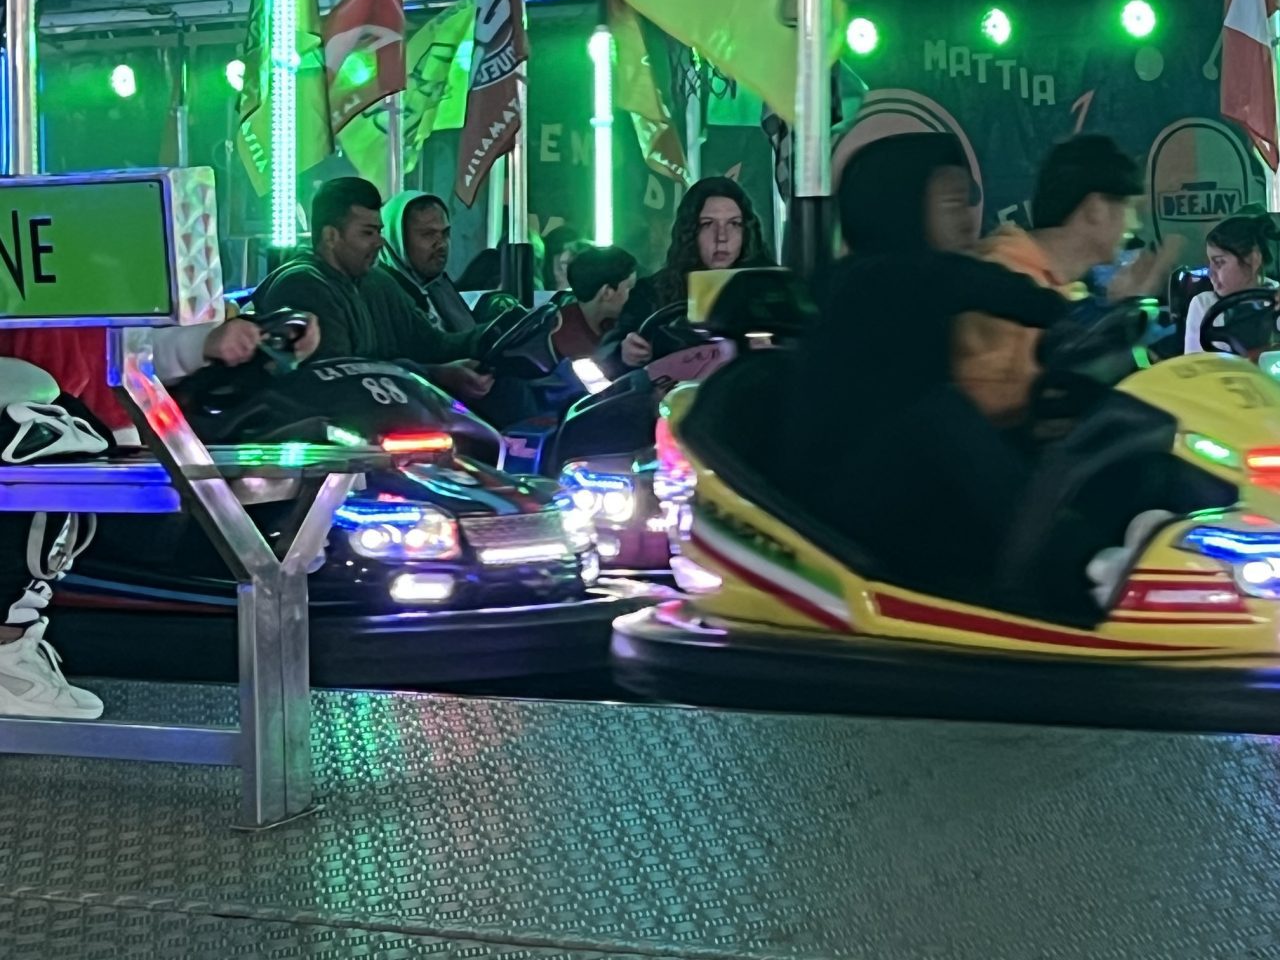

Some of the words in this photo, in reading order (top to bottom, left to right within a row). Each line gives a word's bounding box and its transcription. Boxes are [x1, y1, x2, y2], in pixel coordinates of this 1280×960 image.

[923, 40, 1056, 106] MATTIA
[1162, 192, 1237, 217] DEEJAY
[361, 376, 409, 405] 88
